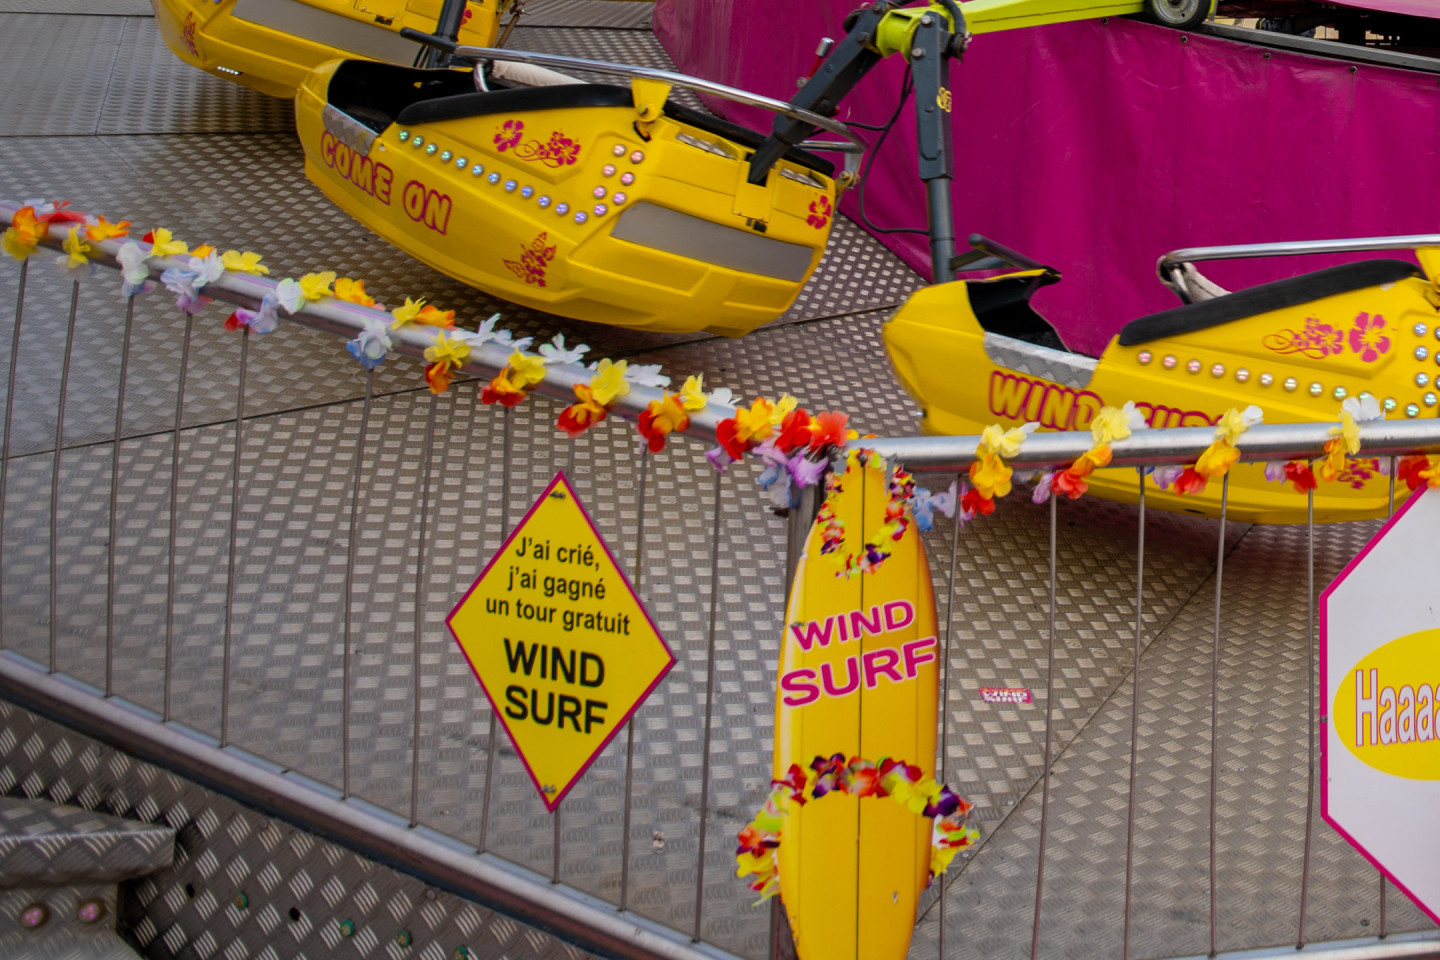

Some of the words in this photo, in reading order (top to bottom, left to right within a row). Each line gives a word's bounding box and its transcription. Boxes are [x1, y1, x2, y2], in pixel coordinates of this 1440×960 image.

[321, 130, 393, 206] COME
[402, 180, 452, 235] ON
[988, 370, 1104, 431] WIND
[516, 537, 550, 560] J'ai
[556, 544, 600, 572] crié,
[507, 566, 537, 591] j'ai
[543, 577, 606, 602] gagné
[486, 597, 510, 617] un
[515, 598, 557, 623] tour
[562, 610, 631, 636] gratuit
[791, 600, 915, 652] WIND
[503, 638, 606, 689] WIND
[780, 636, 937, 707] SURF
[504, 684, 608, 735] SURF
